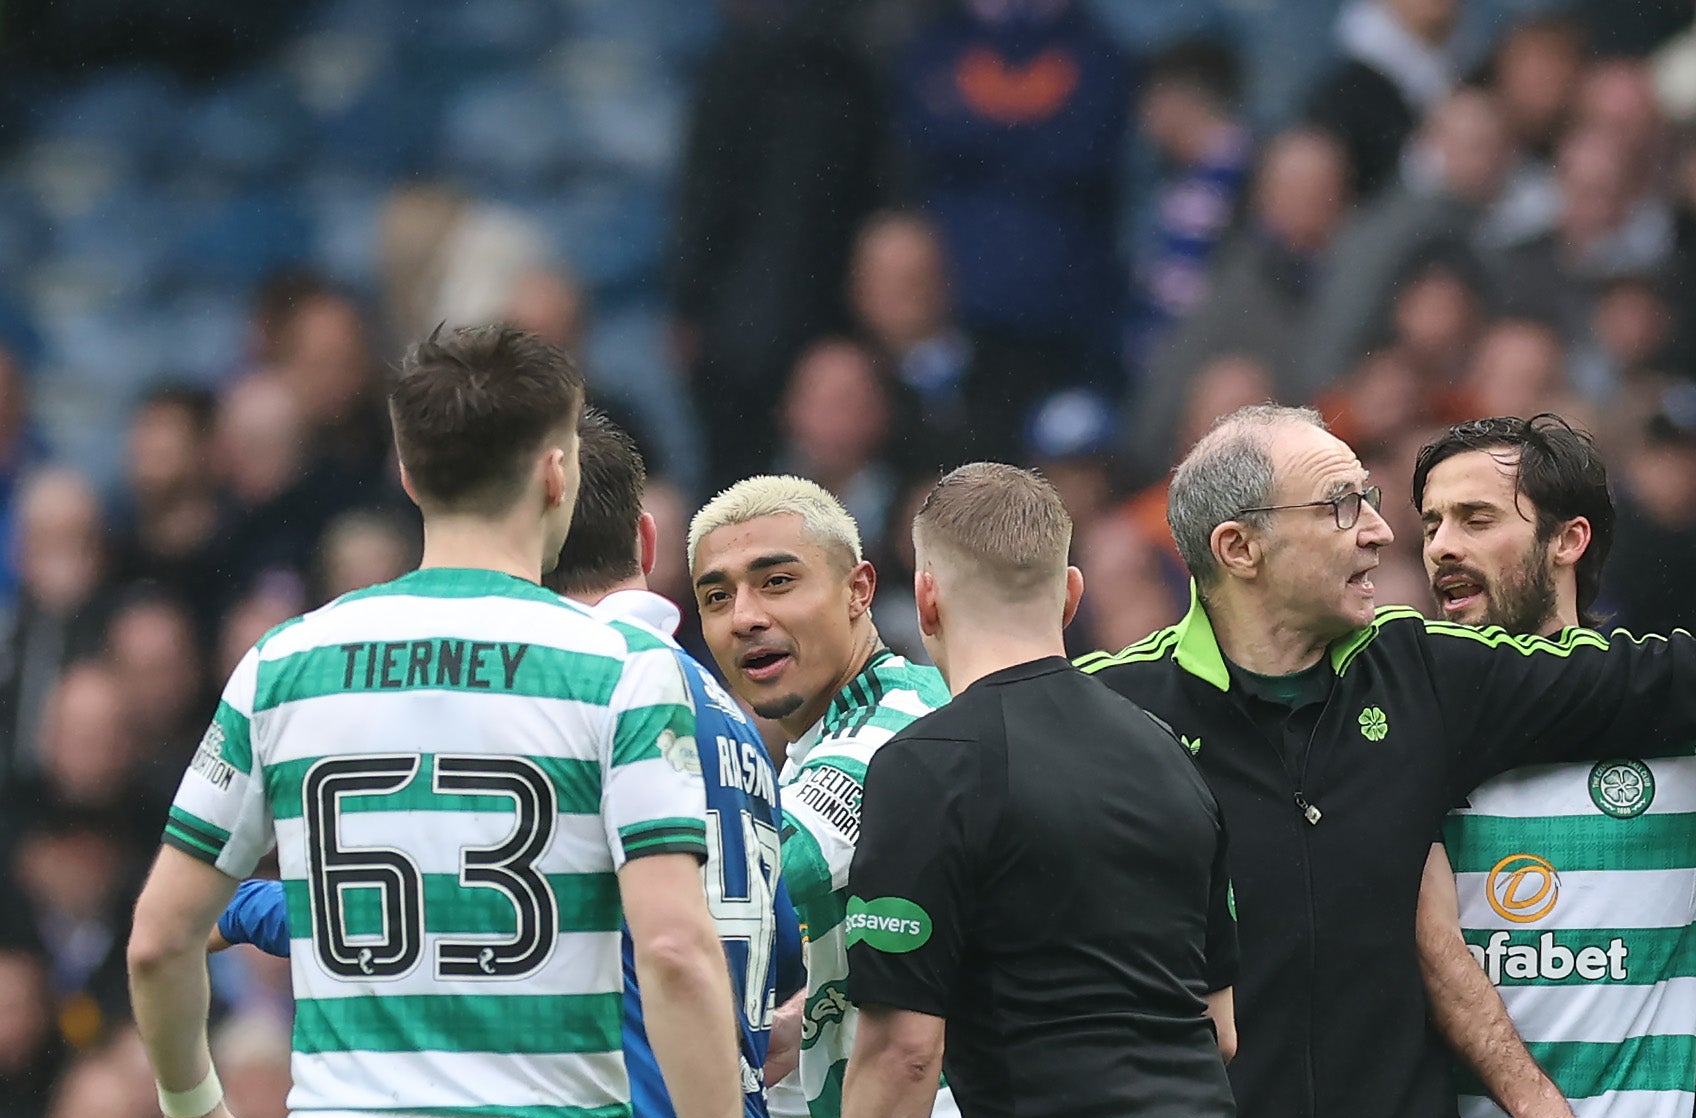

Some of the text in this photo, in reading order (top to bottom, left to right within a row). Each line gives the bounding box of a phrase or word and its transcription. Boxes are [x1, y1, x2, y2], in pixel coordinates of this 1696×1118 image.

[341, 641, 530, 690] TIERNEY
[796, 784, 862, 848] FOUNDAT
[303, 753, 560, 983] 63
